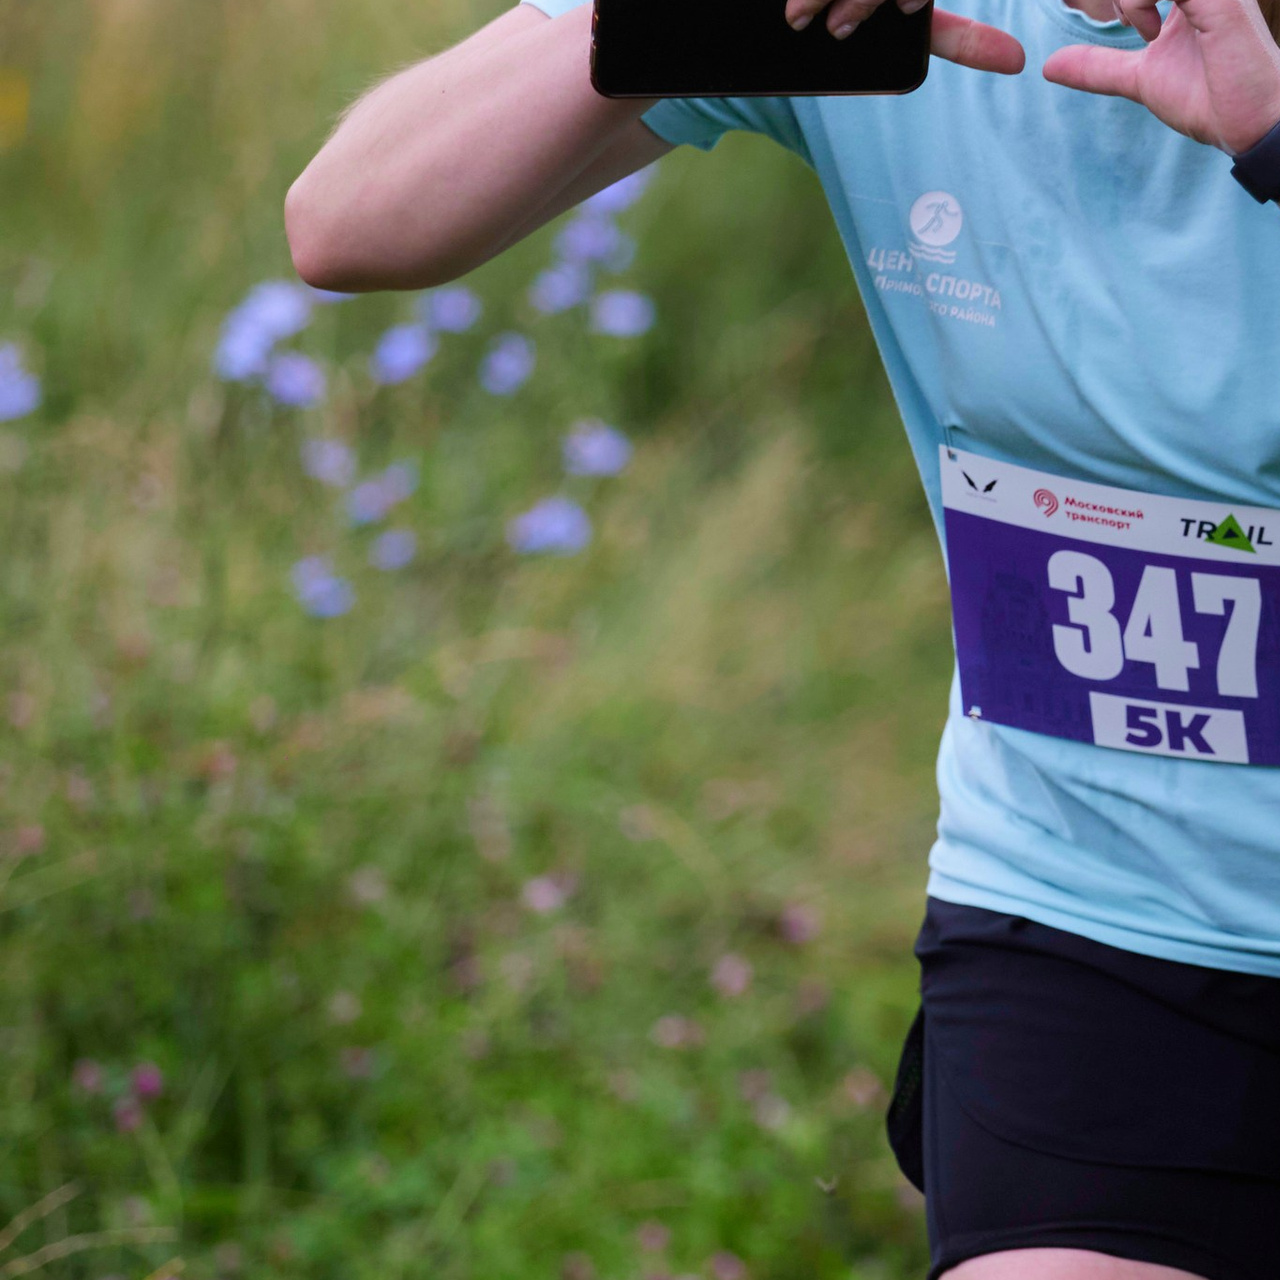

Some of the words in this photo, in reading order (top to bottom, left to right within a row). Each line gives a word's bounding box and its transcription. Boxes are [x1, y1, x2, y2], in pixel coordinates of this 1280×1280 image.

[867, 246, 917, 274] ЦЕН
[925, 272, 1002, 310] СПОРТА
[1064, 496, 1145, 519] Московский
[1065, 511, 1131, 530] транспорт
[1180, 514, 1273, 552] TRAIL
[1046, 549, 1263, 699] 347
[1125, 704, 1216, 755] 5K
